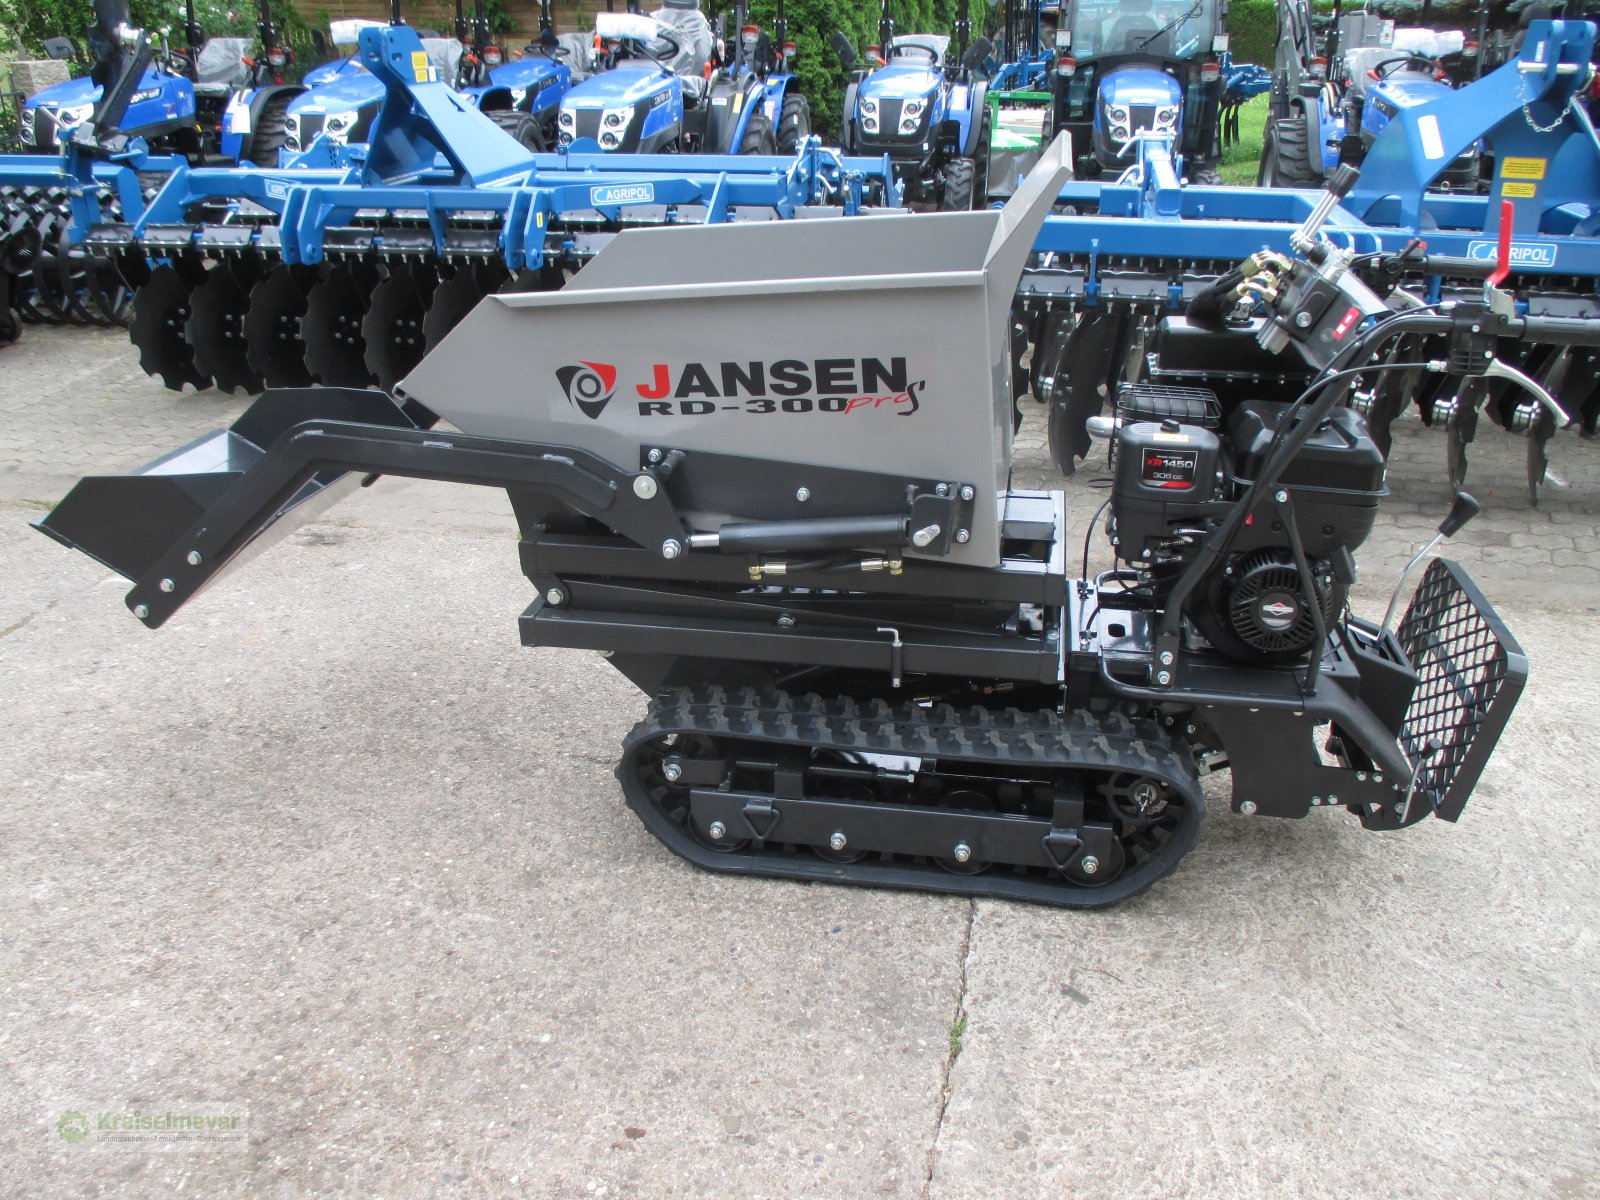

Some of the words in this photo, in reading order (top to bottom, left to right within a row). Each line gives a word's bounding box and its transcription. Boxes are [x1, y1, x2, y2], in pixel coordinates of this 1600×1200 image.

[606, 188, 650, 200] AGRIPOL
[1488, 248, 1550, 262] ARIPOL
[636, 356, 907, 399] JANSEN
[1153, 471, 1172, 480] 306
